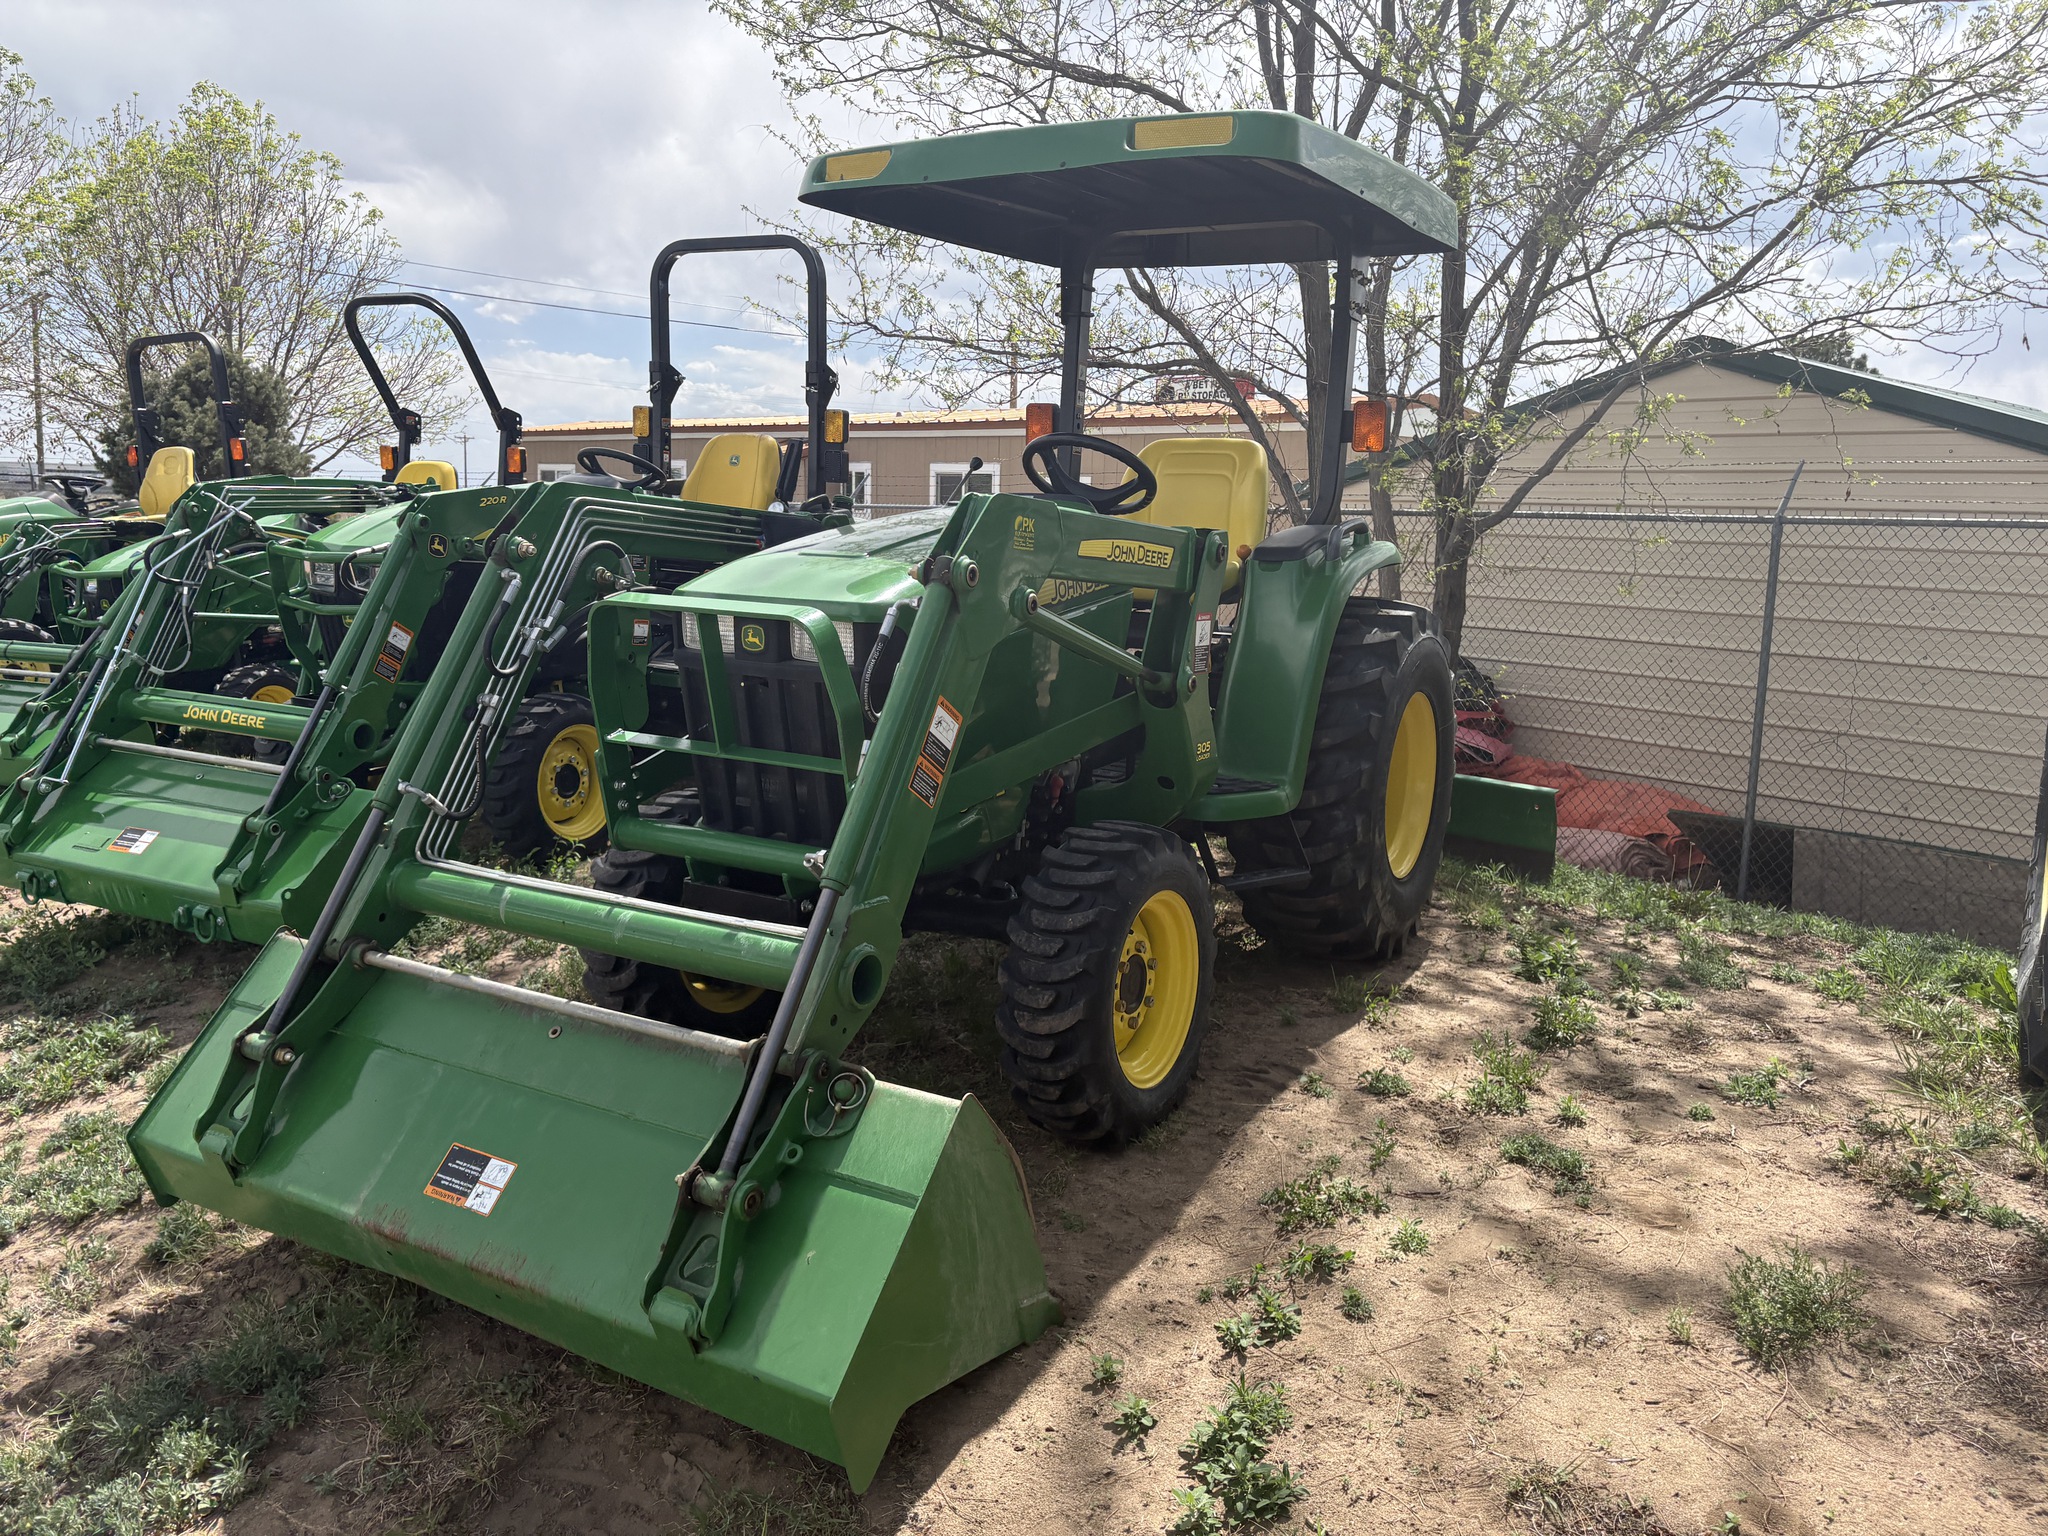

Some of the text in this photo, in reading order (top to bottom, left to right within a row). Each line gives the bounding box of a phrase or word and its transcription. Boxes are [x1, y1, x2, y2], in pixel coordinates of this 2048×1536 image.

[480, 496, 499, 506] 220
[1106, 541, 1169, 566] JOHN DEERE
[183, 705, 266, 729] JOHN DEERE
[1196, 741, 1211, 755] 305
[430, 1188, 455, 1201] WARNING
